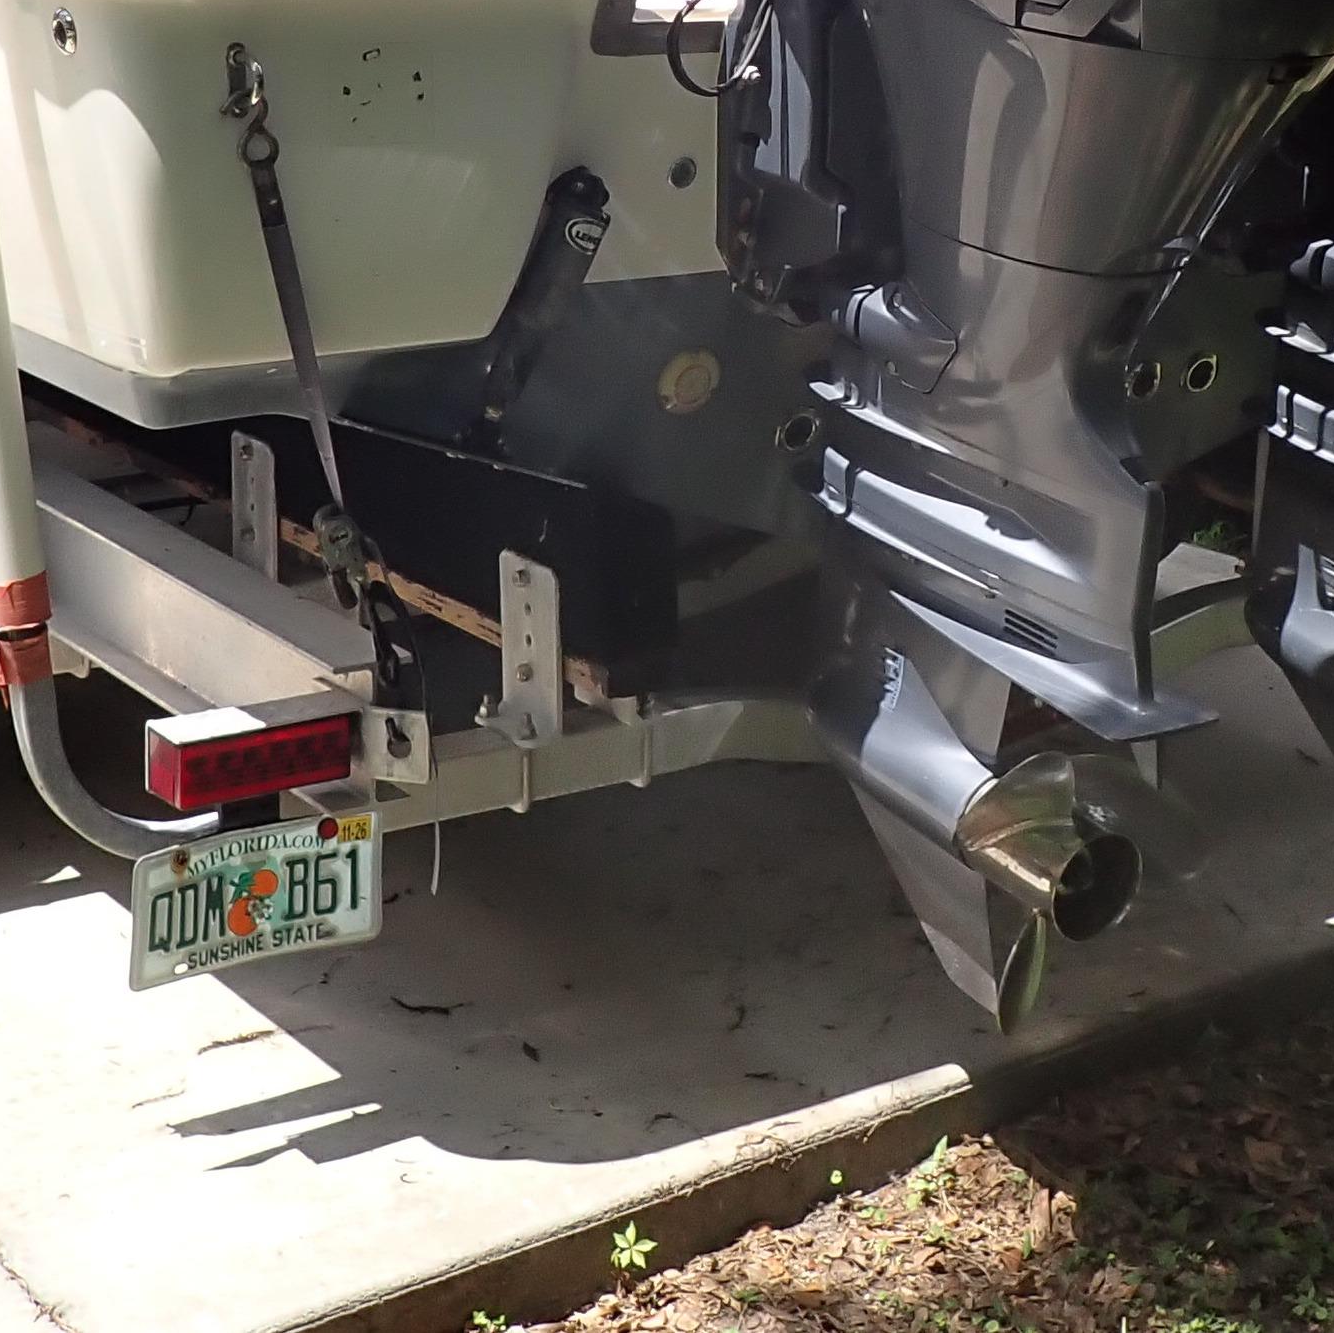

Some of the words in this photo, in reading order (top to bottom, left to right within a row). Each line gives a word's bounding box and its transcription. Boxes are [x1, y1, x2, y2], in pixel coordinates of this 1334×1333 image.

[187, 833, 326, 879] MYFLORIDA.COM
[148, 875, 227, 954] QDM
[283, 849, 361, 922] B61
[187, 932, 265, 970] SUNSHINE
[271, 923, 328, 949] STATE
